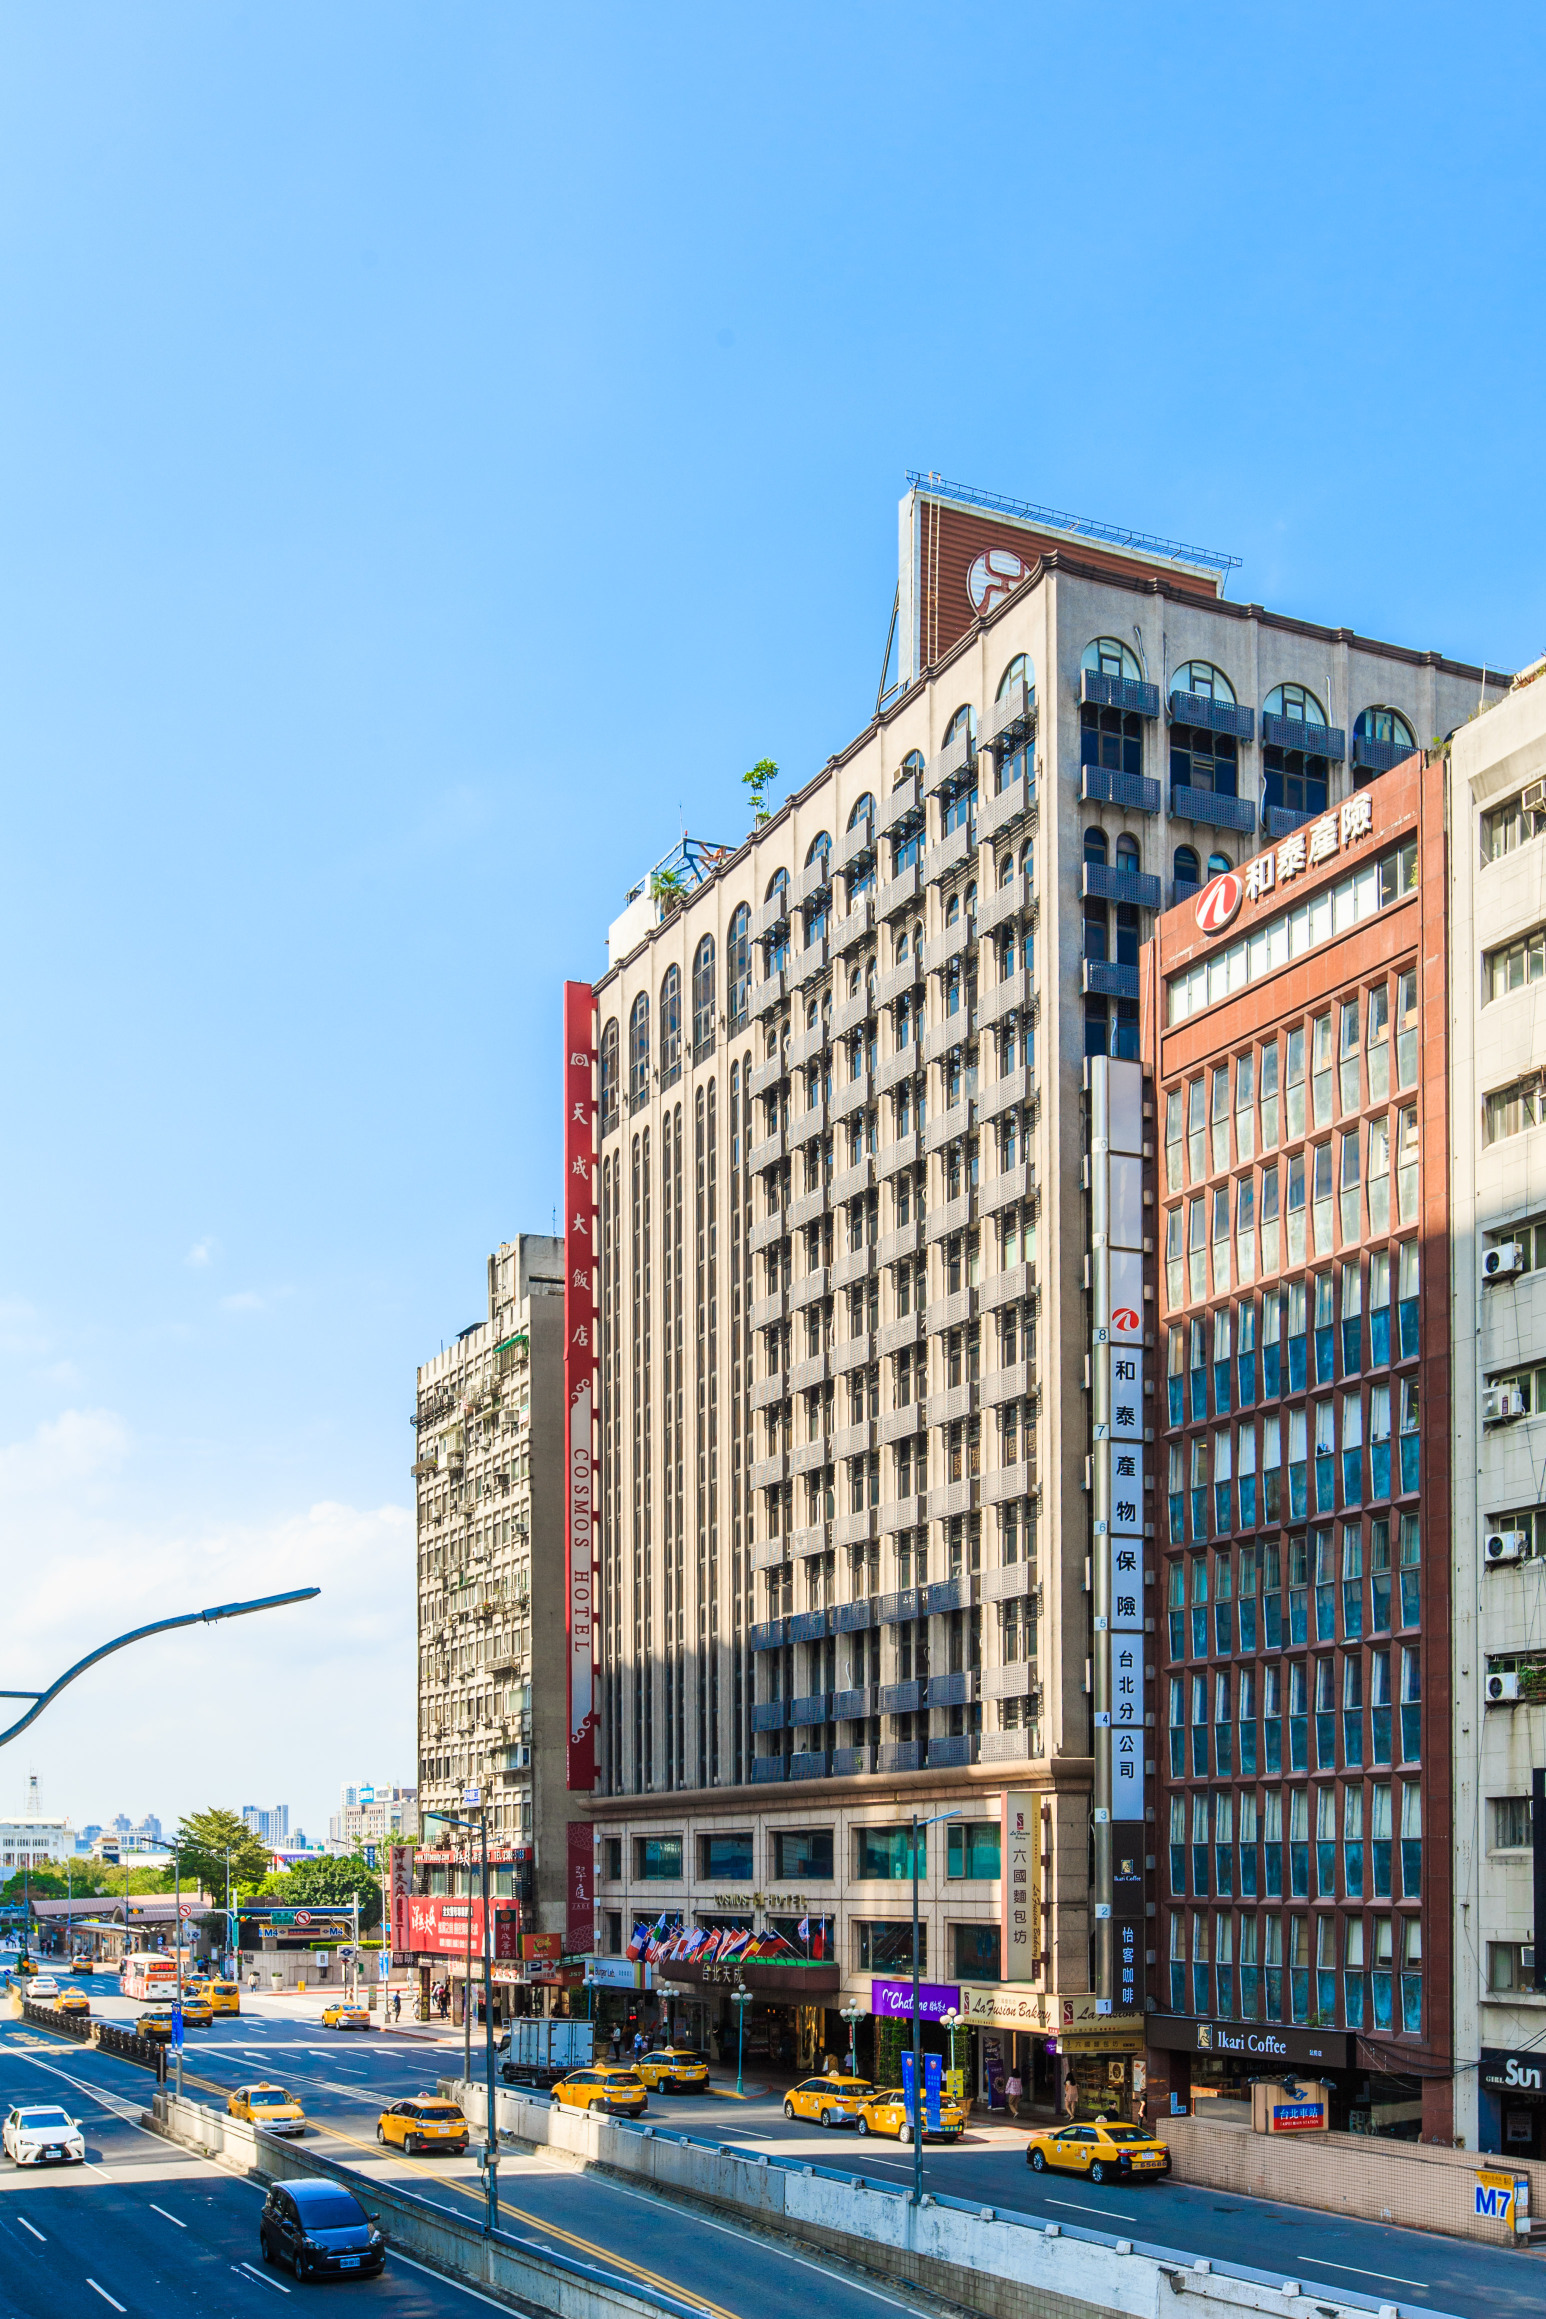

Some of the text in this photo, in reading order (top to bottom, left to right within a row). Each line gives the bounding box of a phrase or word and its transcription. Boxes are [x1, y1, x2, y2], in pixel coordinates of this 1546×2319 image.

[1245, 791, 1372, 900] 和泰產險
[571, 1102, 591, 1347] 天成大飯店
[1099, 1329, 1107, 1341] 8
[1097, 1425, 1106, 1437] 7
[1099, 1522, 1106, 1533] 6
[574, 1448, 589, 1653] COSMOS HOTEL
[1115, 1360, 1137, 1779] 和泰產物保險 台北分公司
[1099, 1618, 1107, 1629] 5
[1102, 1714, 1109, 1724] 4
[1100, 1810, 1107, 1820] 3
[714, 1893, 808, 1908] COSMOS HOTEL
[1013, 1848, 1027, 1944] 六國麵包坊
[1101, 1906, 1108, 1916] 2
[264, 1928, 278, 1937] M4
[329, 1927, 344, 1936] M4
[393, 1953, 414, 1964] 咖啡
[1122, 1926, 1134, 2004] 怡客咖啡
[702, 1963, 745, 1984] 台北天成
[890, 1991, 928, 2012] Chatme
[1104, 2001, 1109, 2011] 1
[1019, 2001, 1052, 2024] Bakery
[1217, 2030, 1287, 2054] Ikari Coffee
[1485, 2058, 1541, 2089] GIRL Sun
[1279, 2107, 1318, 2120] 台北車站
[1475, 2186, 1512, 2219] M7
